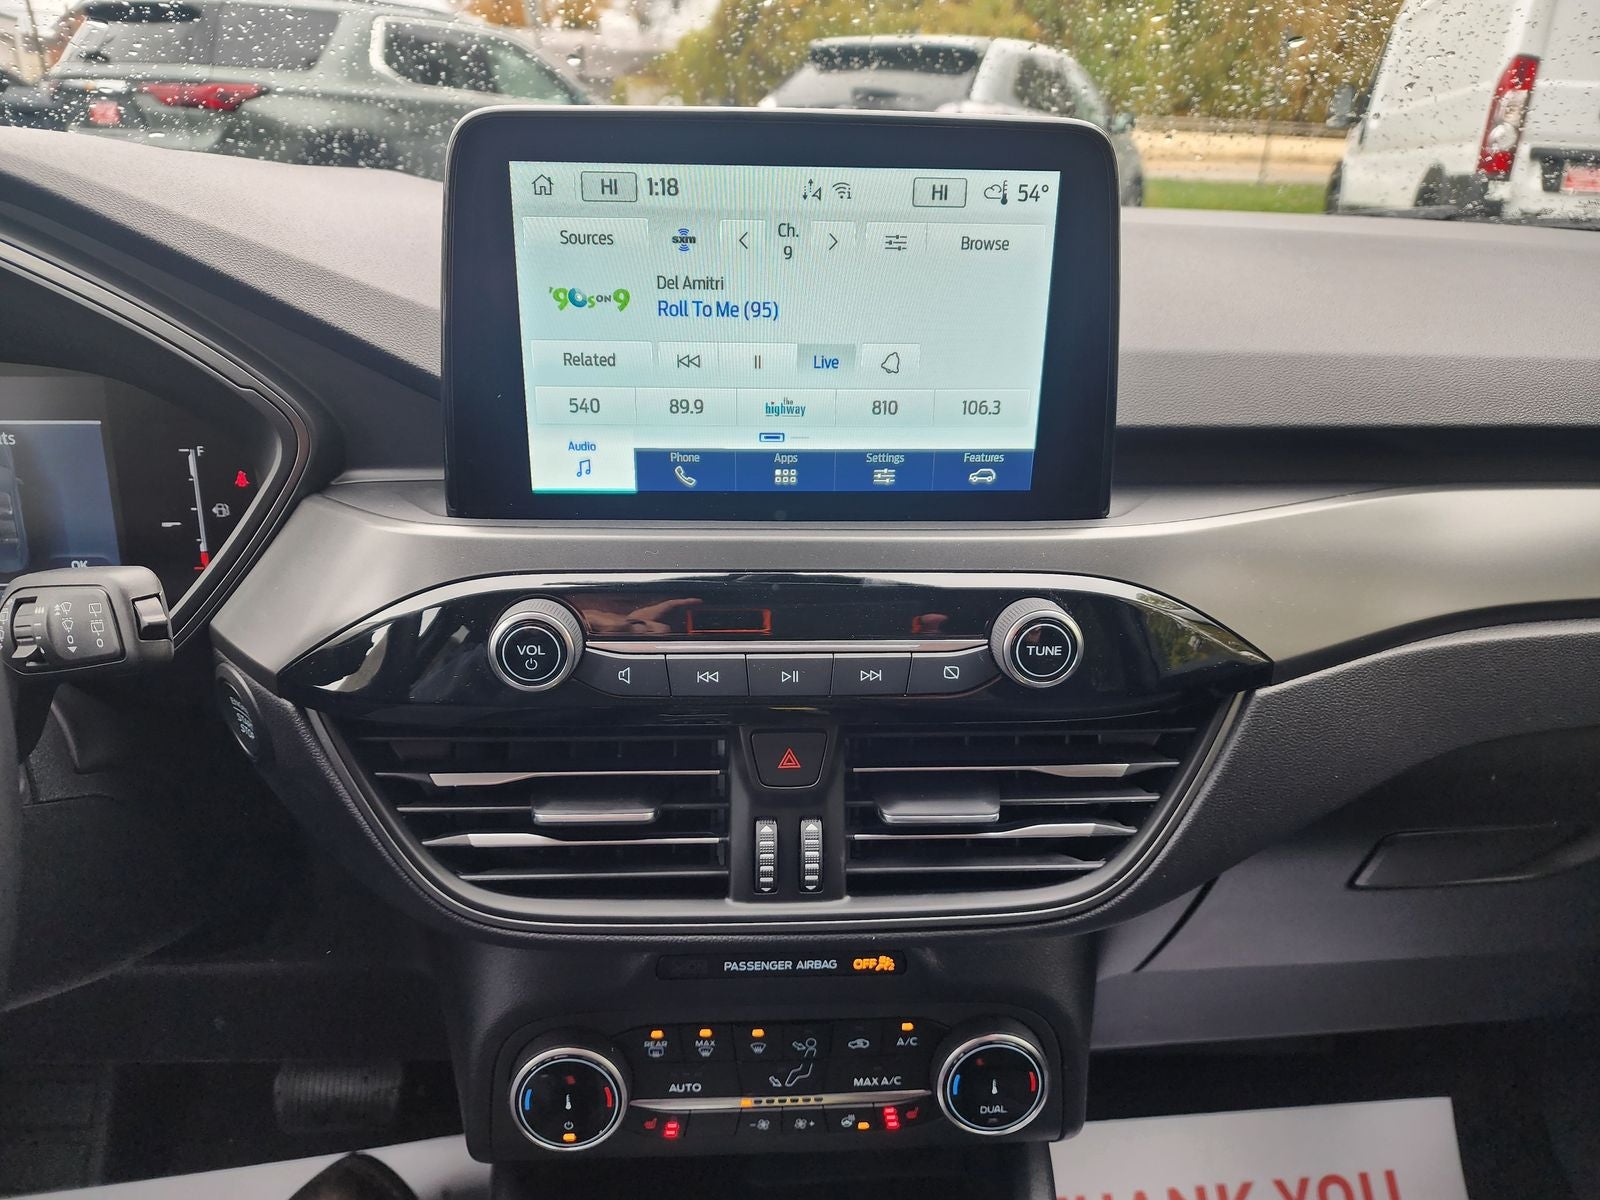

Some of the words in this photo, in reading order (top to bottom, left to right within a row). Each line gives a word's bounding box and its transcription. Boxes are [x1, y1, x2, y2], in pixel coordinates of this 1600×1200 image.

[600, 179, 618, 195] HI
[647, 177, 679, 196] 1:18
[931, 184, 948, 201] HI
[778, 222, 799, 238] Ch.
[560, 230, 614, 246] Sources
[671, 236, 697, 245] sxm
[961, 236, 1010, 251] Browse
[783, 246, 793, 260] 9
[657, 276, 679, 290] Del
[682, 276, 724, 291] Amitri
[613, 288, 630, 312] 9
[658, 300, 688, 317] Roll
[695, 302, 713, 317] To
[716, 302, 740, 317] Me
[744, 301, 779, 319] (95)
[563, 352, 616, 367] Related
[813, 355, 839, 370] Live
[569, 397, 601, 414] 540
[669, 398, 704, 415] 89.9
[765, 402, 806, 417] highway
[872, 399, 899, 416] 810
[962, 400, 1001, 416] 106.3
[568, 441, 597, 453] Audio
[670, 452, 700, 464] Phone
[774, 452, 798, 465] Apps
[866, 452, 905, 465] Settings
[963, 452, 1005, 464] Features
[516, 644, 546, 656] VOL
[1026, 645, 1062, 656] TUNE
[723, 960, 793, 972] PASSENGER
[795, 959, 838, 970] AIRBAG
[853, 957, 878, 970] OFF
[695, 1039, 716, 1048] MAX
[896, 1037, 918, 1047] A/C
[668, 1082, 702, 1093] AUTO
[853, 1077, 879, 1087] MAX
[880, 1075, 902, 1086] A/C
[979, 1104, 1008, 1115] DUAL
